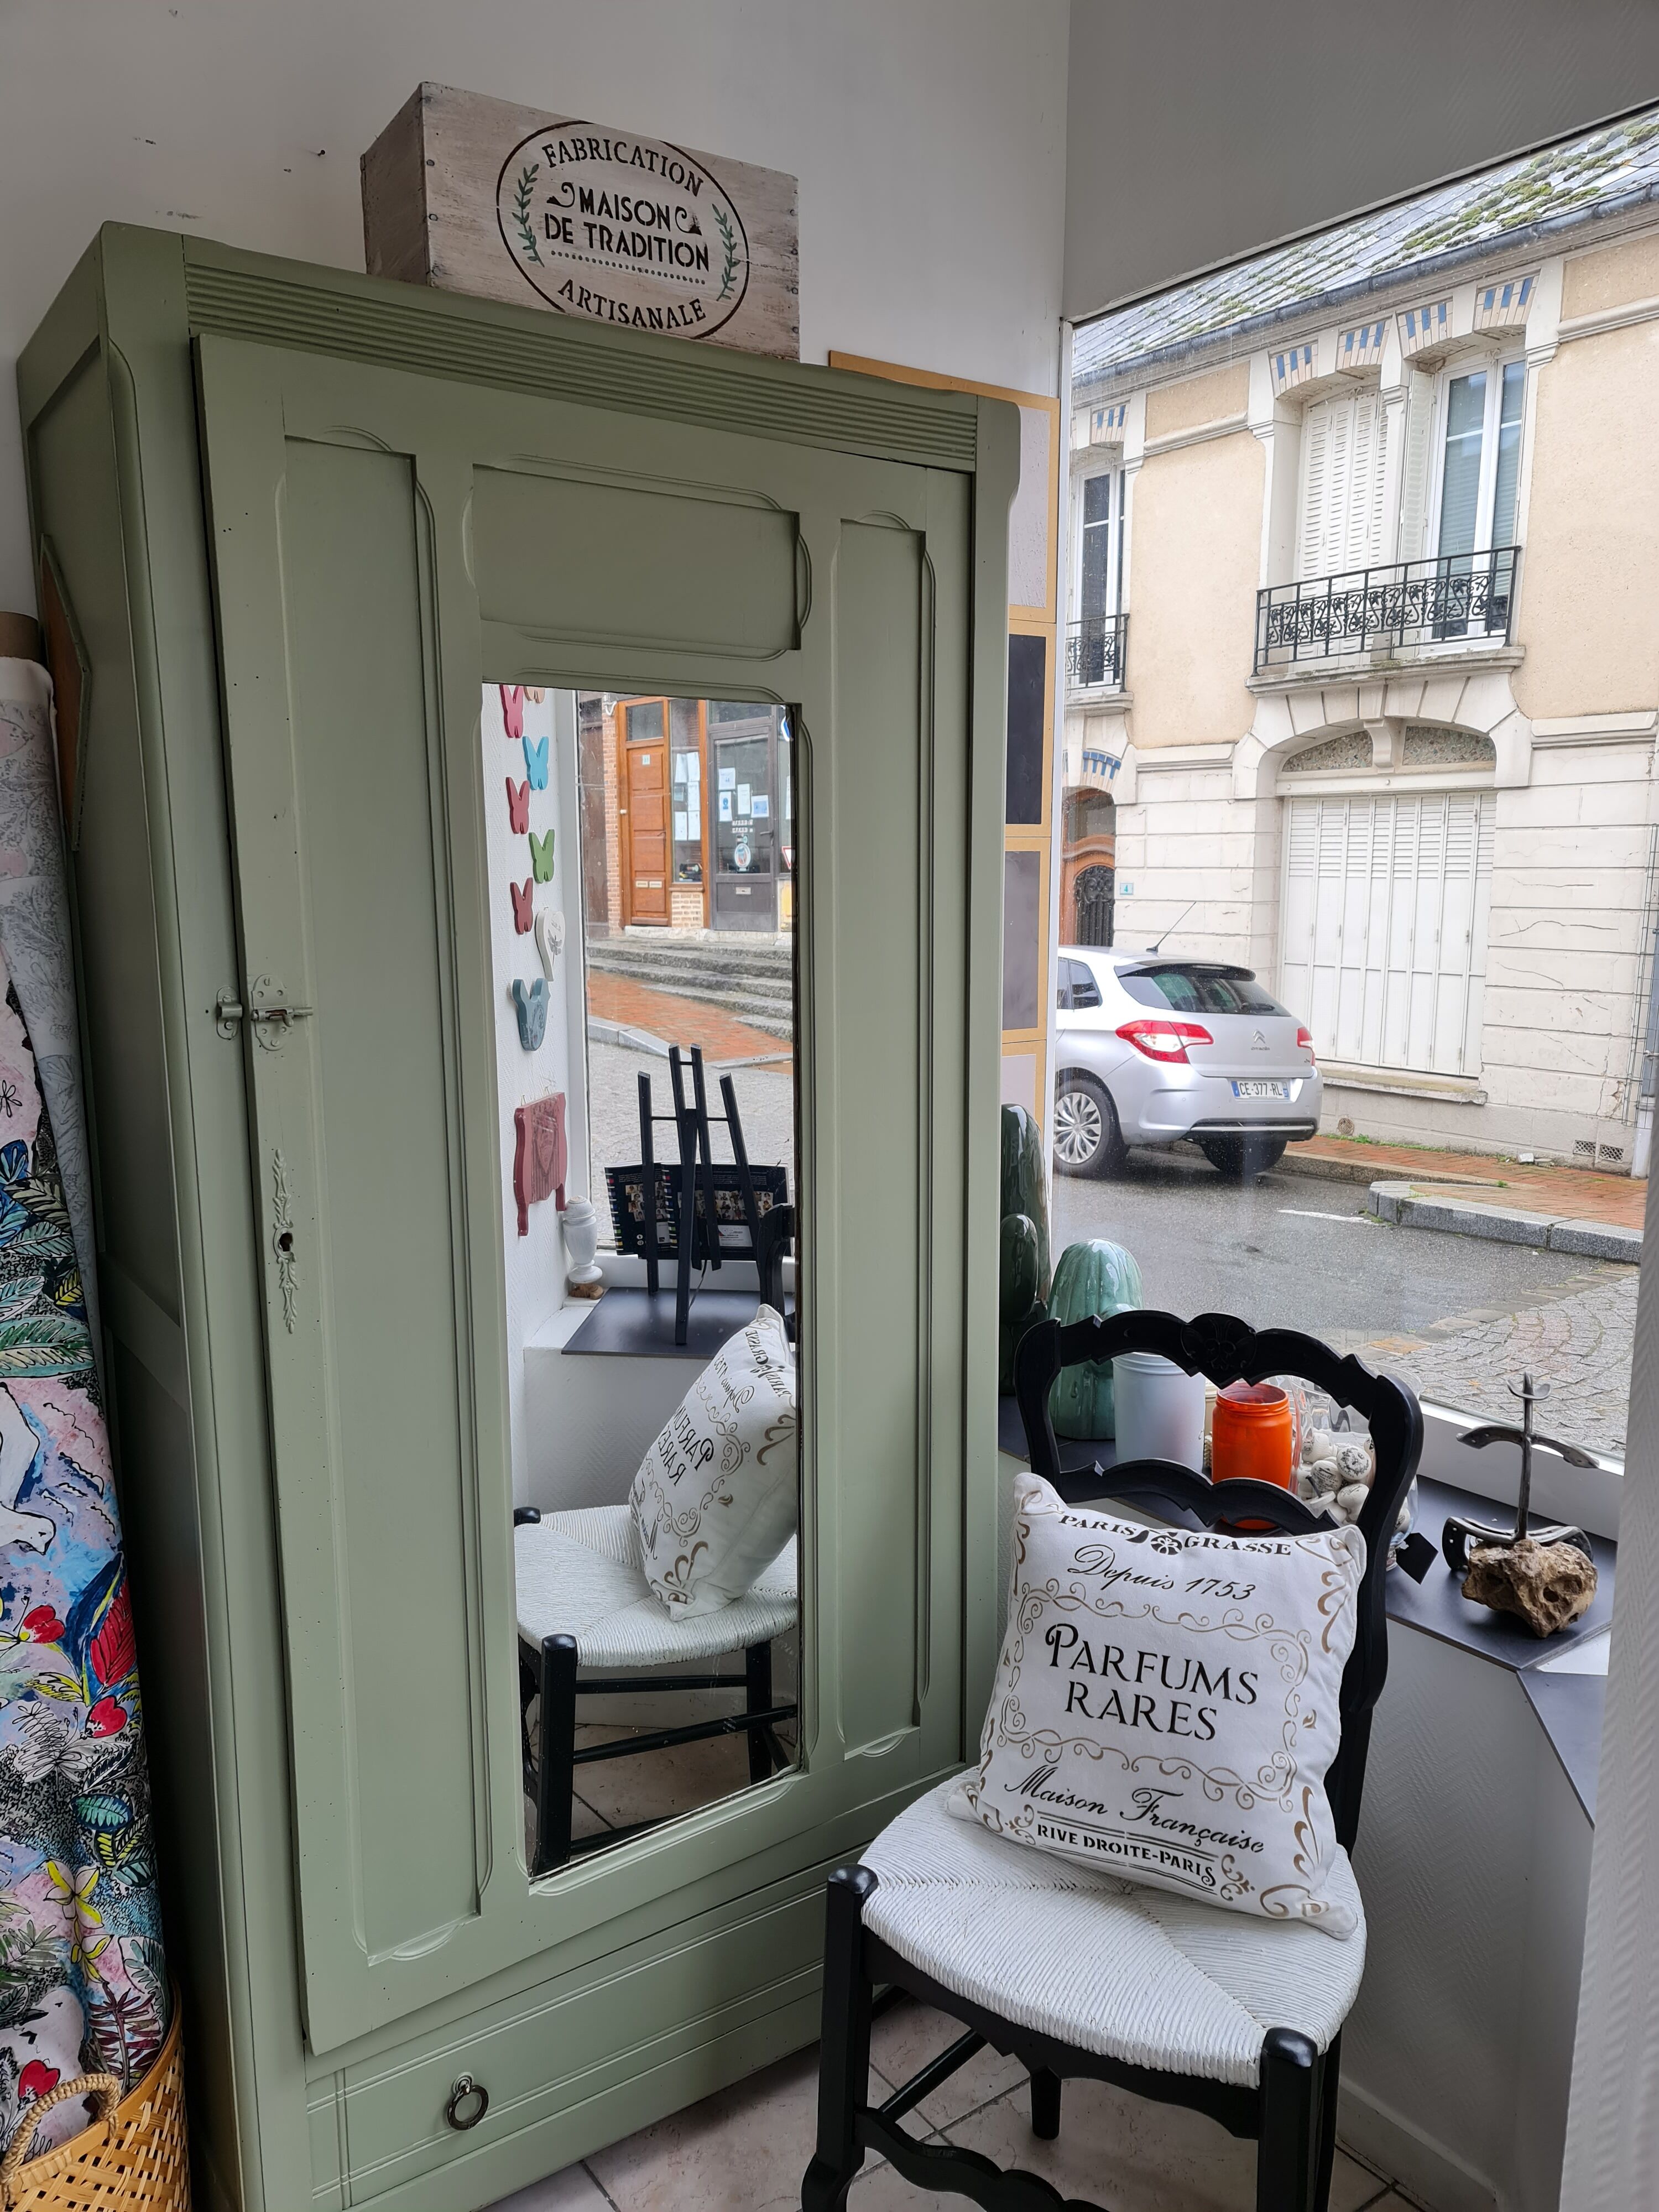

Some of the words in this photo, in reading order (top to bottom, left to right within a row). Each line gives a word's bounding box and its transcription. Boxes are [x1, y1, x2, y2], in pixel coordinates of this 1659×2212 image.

[541, 138, 703, 197] FABRICATION
[578, 186, 671, 231] MAISON
[544, 213, 574, 244] DE
[583, 222, 709, 272] TRADITION
[557, 279, 707, 330] ARTISANALE
[1239, 1082, 1283, 1096] CE-377-RL
[1058, 1515, 1137, 1536] PARIS
[1185, 1535, 1292, 1556] GRASSE
[1067, 1543, 1176, 1591] Depuis
[1185, 1578, 1257, 1601] 1753
[1045, 1623, 1259, 1705] PARFUMS
[1064, 1681, 1218, 1742] RARES
[1004, 1765, 1109, 1815] Maison
[1120, 1787, 1264, 1853] Française
[1037, 1824, 1078, 1846] RIVE
[1083, 1837, 1217, 1887] DROITE-PARIS
